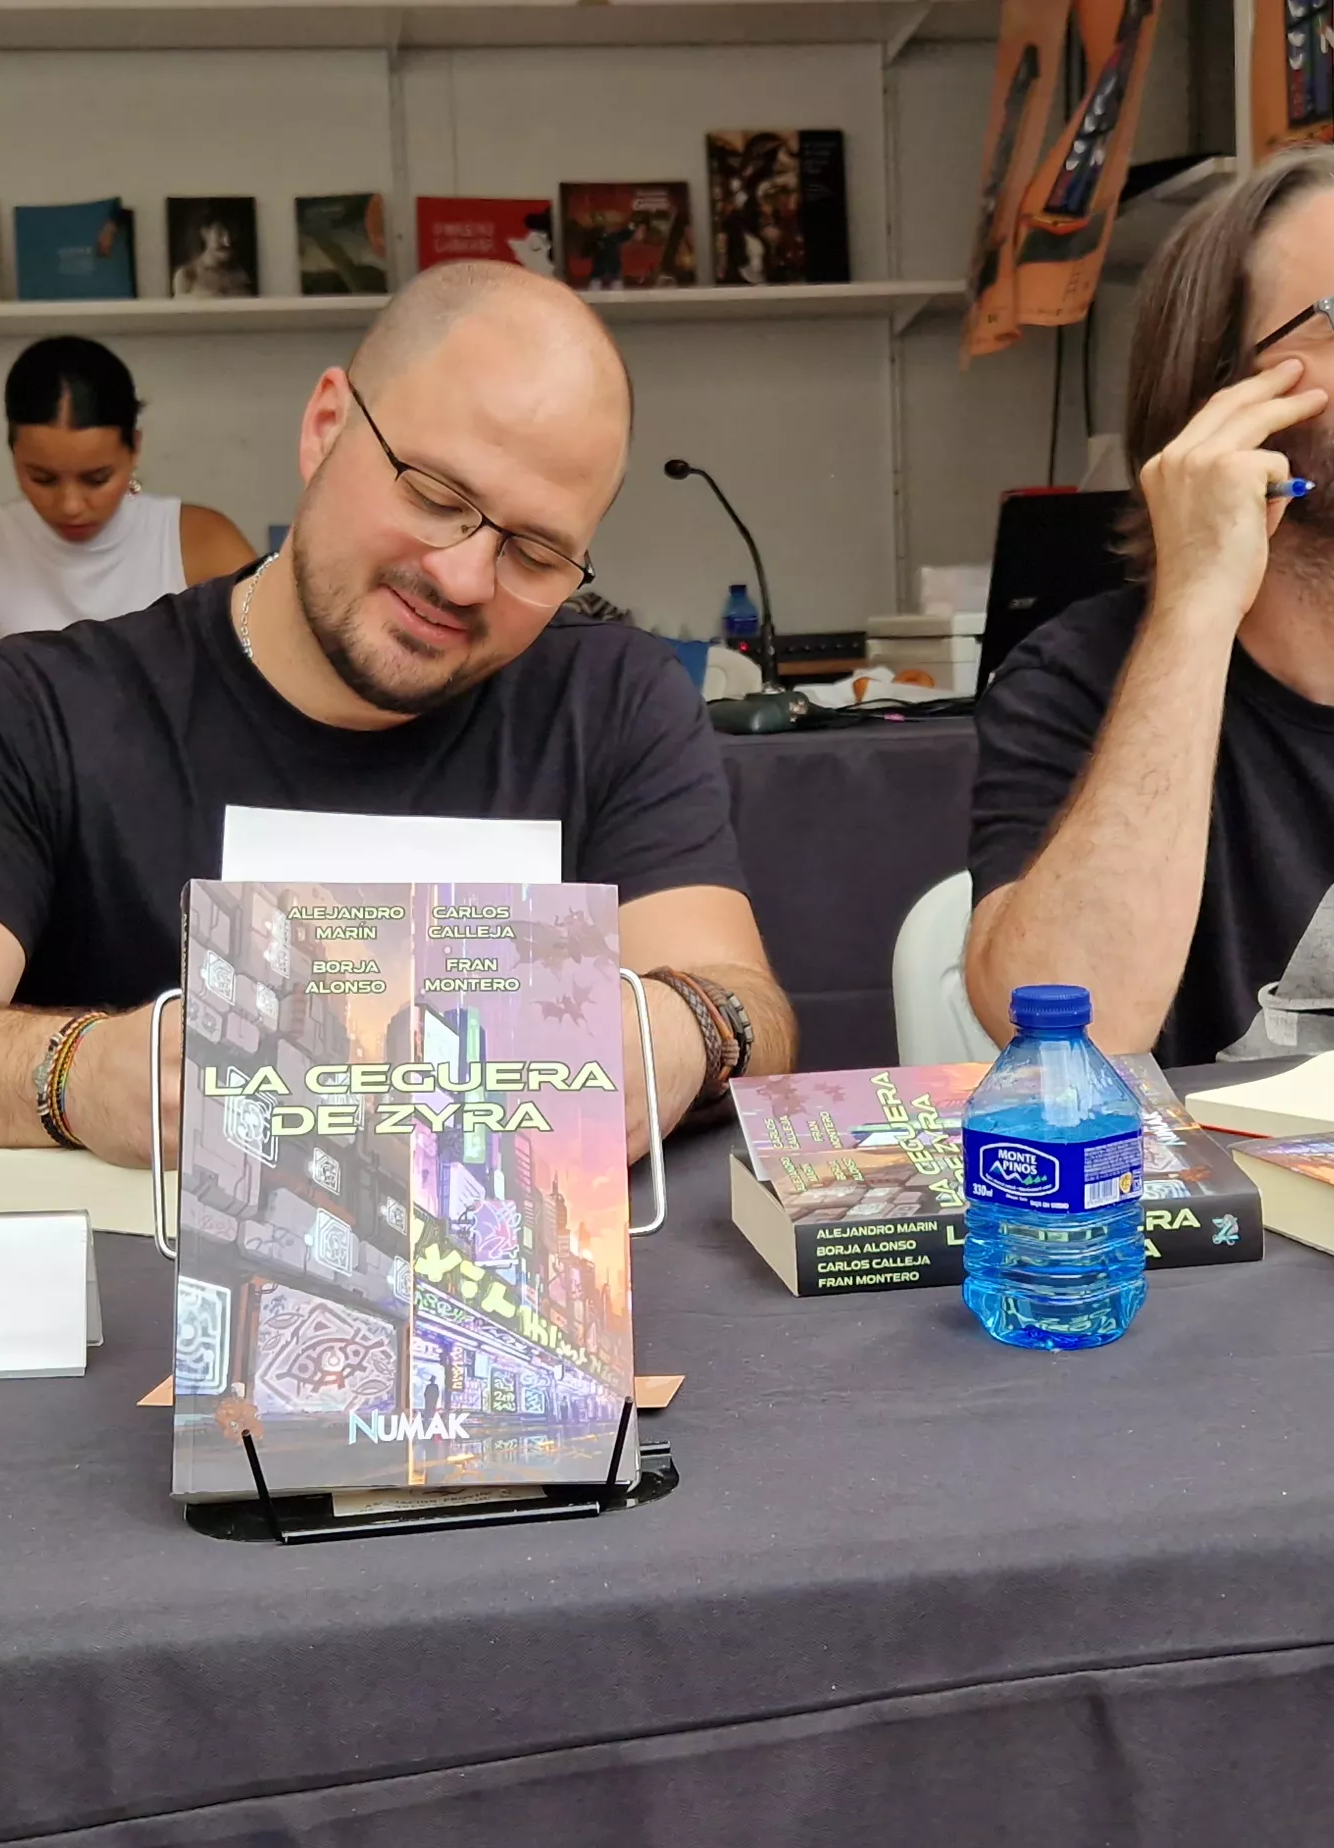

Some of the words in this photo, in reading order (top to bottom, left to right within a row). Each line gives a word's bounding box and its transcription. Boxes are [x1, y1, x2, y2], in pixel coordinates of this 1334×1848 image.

[288, 904, 406, 921] ALEJANDRO
[432, 904, 511, 920] CARLOS
[315, 921, 378, 940] MARÍN
[427, 924, 516, 940] CALLEJA
[312, 959, 380, 975] BORJA
[445, 957, 499, 973] FRAN
[304, 978, 386, 994] ALONSO
[424, 977, 521, 993] MONTERO
[203, 1064, 292, 1098] LA
[304, 1060, 619, 1095] CEGUERA
[270, 1105, 365, 1137] DE
[374, 1101, 555, 1135] ZYRA
[997, 1149, 1038, 1165] MONTE
[1002, 1160, 1038, 1176] PINOS
[816, 1222, 895, 1240] ALEJANDRO
[816, 1243, 862, 1257] BORJA
[863, 1240, 917, 1253] ALONSO
[817, 1258, 870, 1273] CARLOS
[872, 1255, 932, 1268] CALLEJA
[818, 1276, 853, 1289] FRAN
[855, 1271, 920, 1287] MONTERO
[348, 1409, 471, 1445] NUMAK
